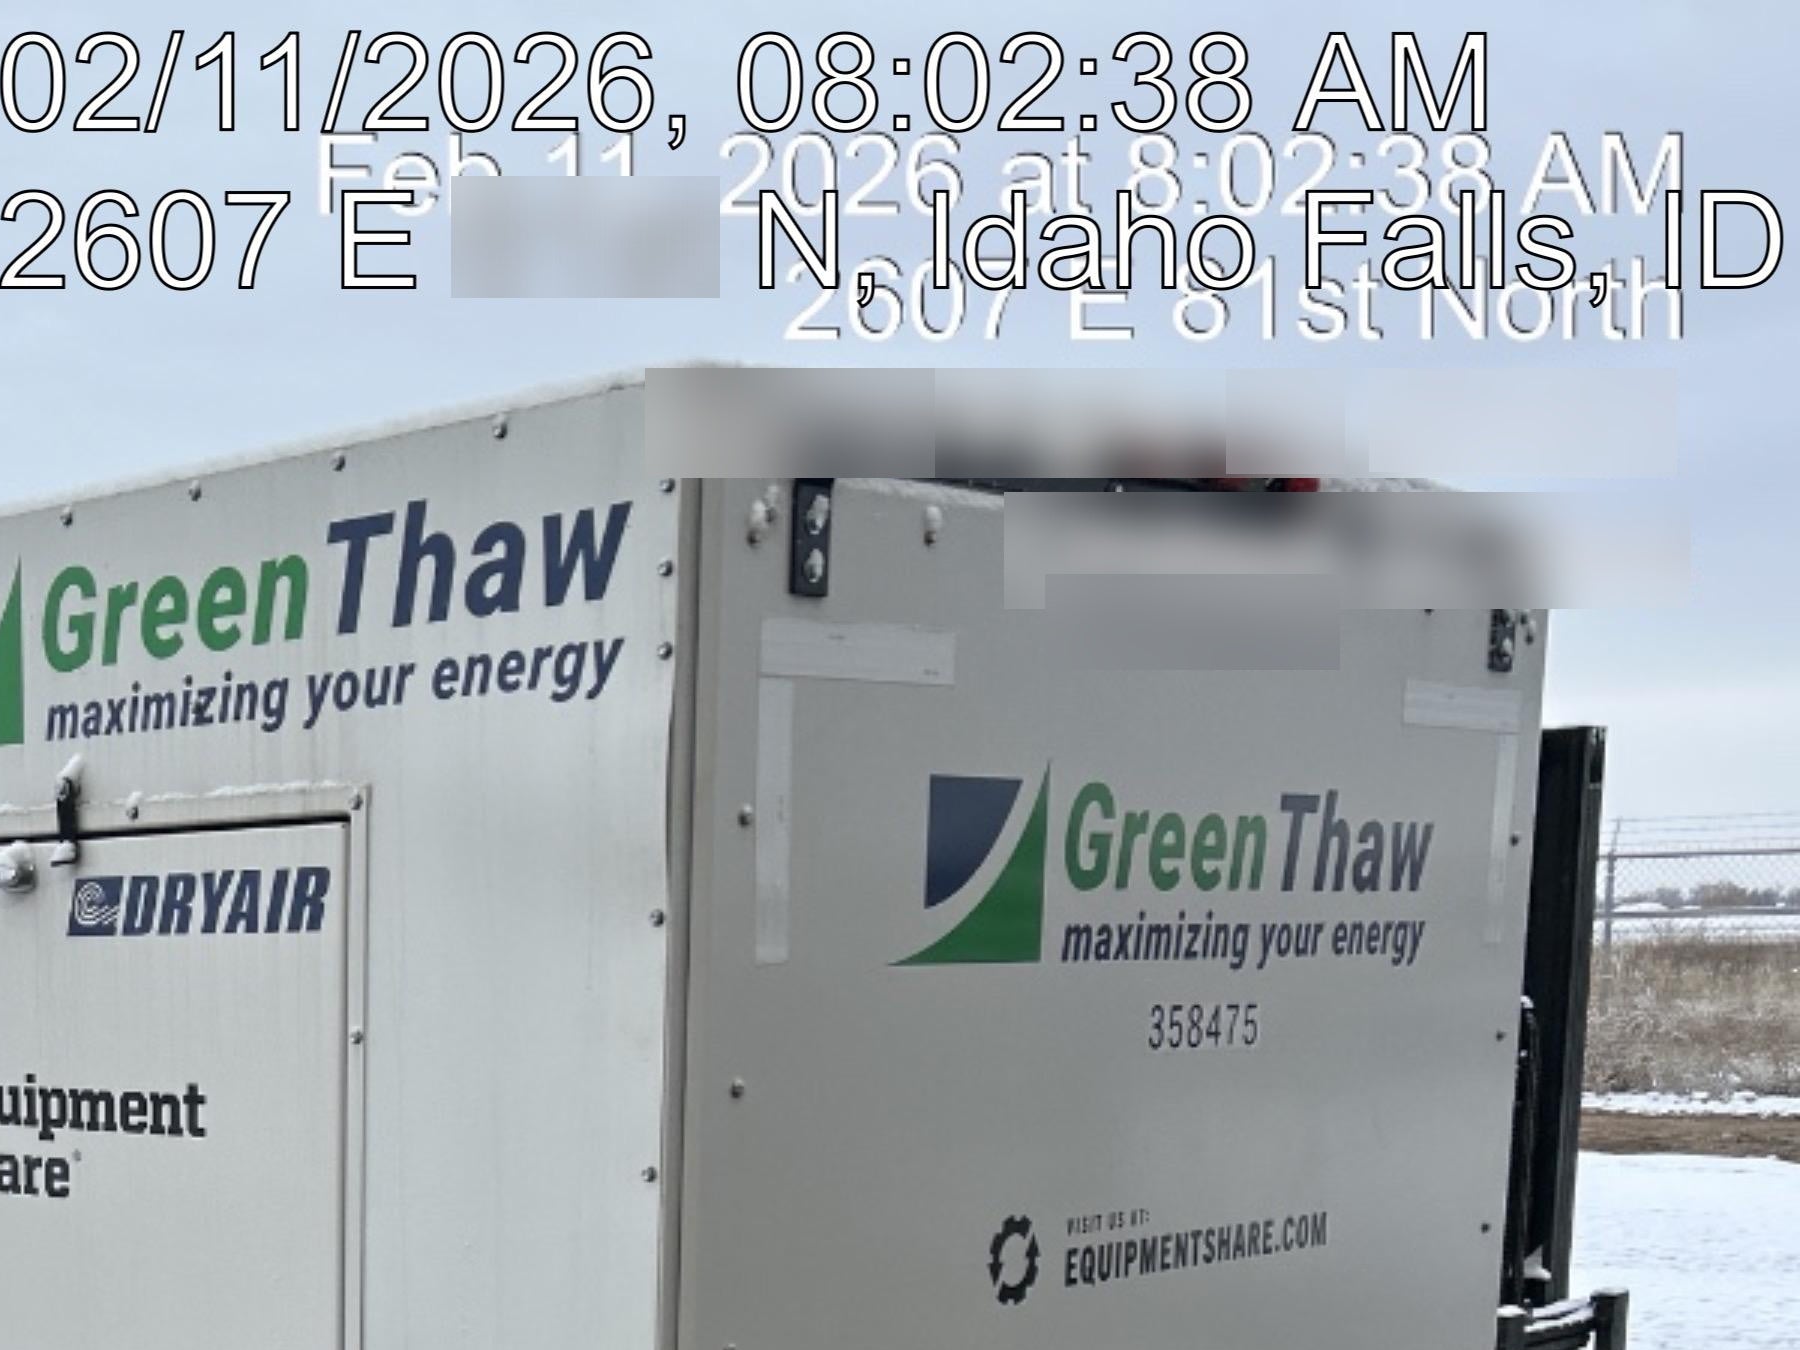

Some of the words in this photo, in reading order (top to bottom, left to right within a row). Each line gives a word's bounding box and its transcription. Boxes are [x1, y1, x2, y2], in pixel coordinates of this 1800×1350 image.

[45, 669, 289, 741] maximizing
[303, 662, 417, 729] your
[431, 636, 625, 702] energy
[122, 866, 331, 936] DRYAIR
[1061, 909, 1250, 970] maximizing
[1256, 919, 1324, 969] your
[1331, 919, 1426, 966] energy
[1149, 1004, 1258, 1049] 358475
[1064, 1211, 1328, 1287] EQUIPMENTSHARE.COM
